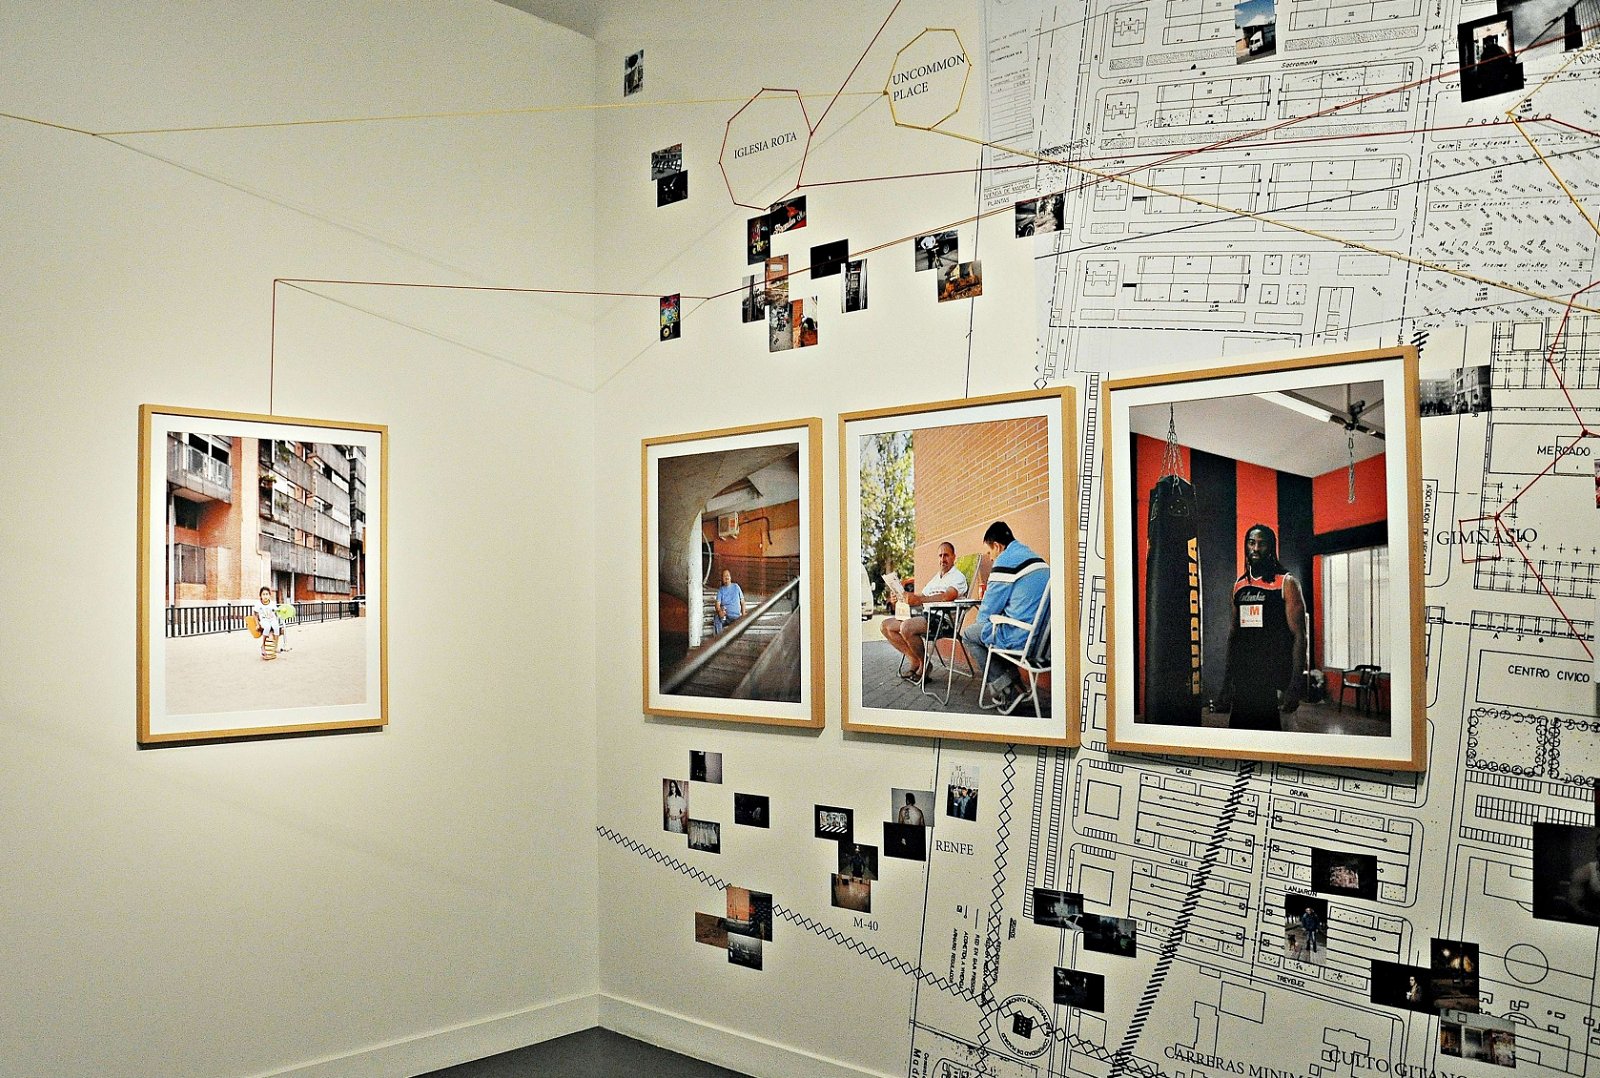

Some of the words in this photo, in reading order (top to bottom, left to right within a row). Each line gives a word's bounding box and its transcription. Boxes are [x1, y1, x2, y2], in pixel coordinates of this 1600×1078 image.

[892, 52, 966, 86] UNCOMMON
[1281, 60, 1318, 68] Sacromonte
[893, 81, 929, 102] PLACE
[734, 142, 769, 159] IGLESIA
[770, 131, 797, 149] ROTA
[1537, 445, 1591, 457] MERCADO
[1436, 527, 1538, 546] GIMNASIO
[1187, 537, 1200, 695] BUDDHA
[1507, 664, 1551, 679] CENTRO
[1556, 670, 1591, 684] CIVICO
[1175, 767, 1193, 776] CALLE
[935, 839, 975, 856] RENFE
[1170, 857, 1188, 868] CALLE
[852, 916, 879, 932] M-40
[1276, 974, 1306, 988] TREVELEZ
[1164, 1046, 1244, 1074] CARRERAS
[1329, 1049, 1389, 1073] CULTO
[1394, 1062, 1468, 1078] GITAN
